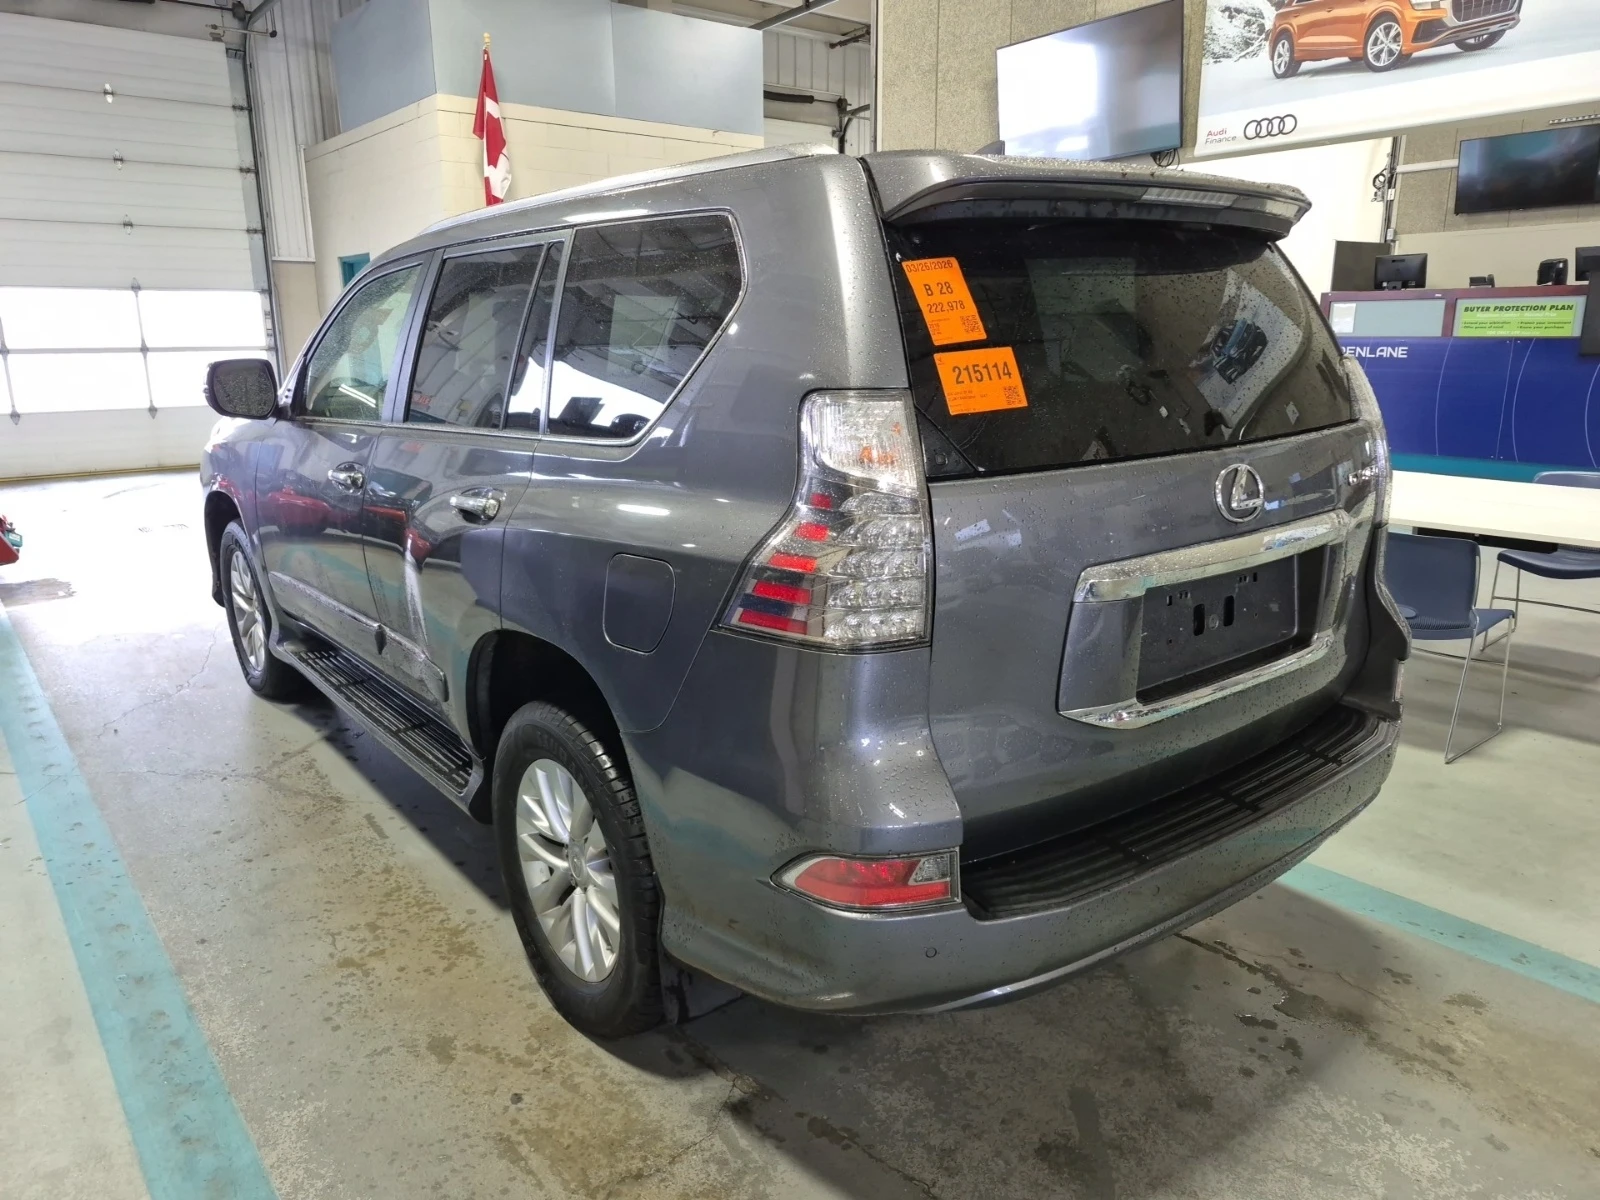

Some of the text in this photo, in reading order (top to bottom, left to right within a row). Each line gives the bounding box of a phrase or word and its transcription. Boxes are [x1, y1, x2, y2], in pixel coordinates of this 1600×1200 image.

[1206, 128, 1227, 137] Audi
[1205, 135, 1237, 144] Finance
[906, 260, 953, 273] 03/26/2026
[923, 281, 953, 296] B 28
[927, 300, 965, 313] 222,978
[952, 361, 1012, 385] 215114
